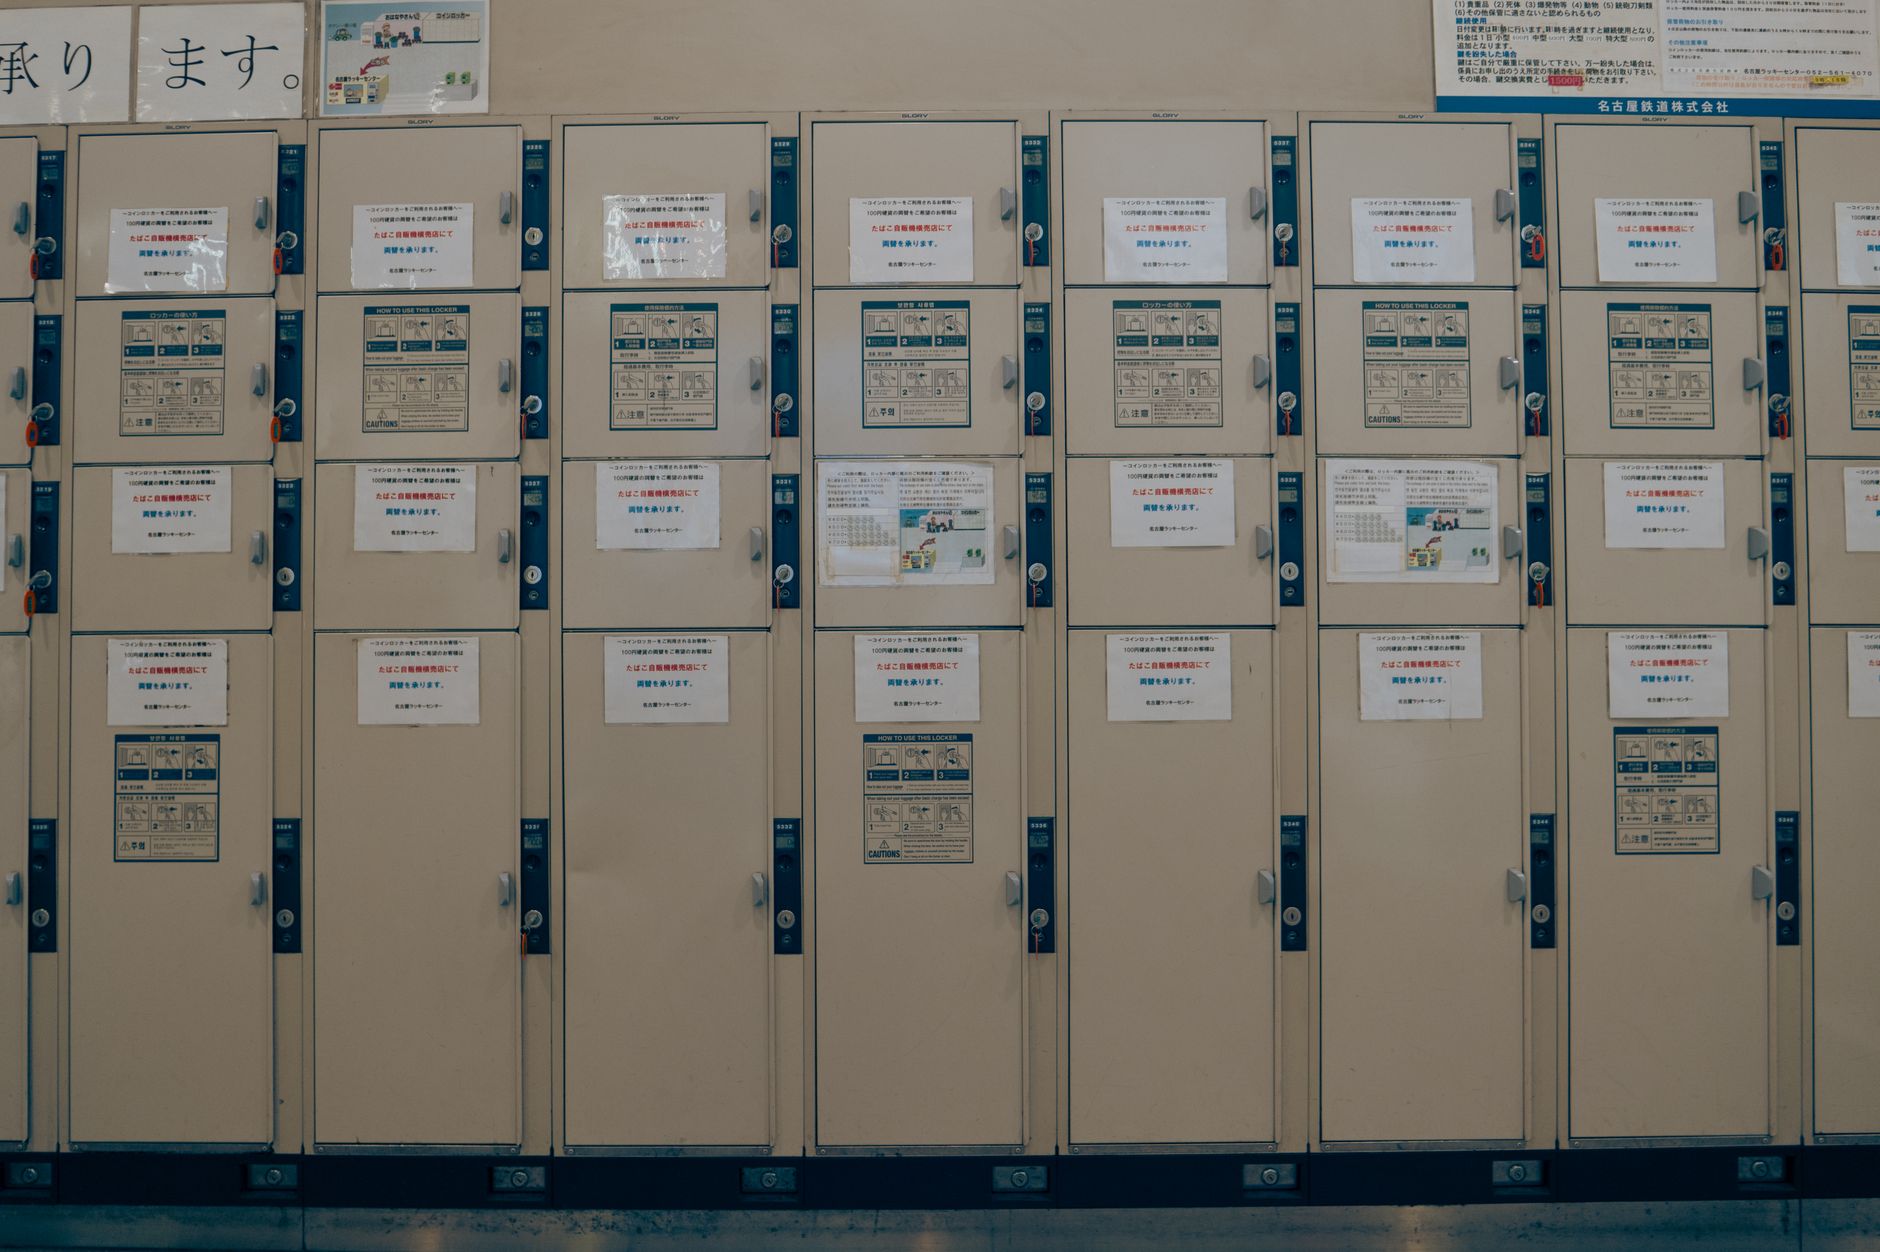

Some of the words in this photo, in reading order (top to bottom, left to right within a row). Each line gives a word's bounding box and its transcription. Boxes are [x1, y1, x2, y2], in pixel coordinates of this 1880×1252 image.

[161, 34, 300, 90] ます。
[0, 41, 92, 94] 承り
[1598, 100, 1729, 113] 名古屋鉄道株式会社
[866, 209, 958, 217] 100円硬貨の両替をご希望のお客様は
[1120, 209, 1210, 217] 100円硬貨の両替をご希望のお客様は
[1368, 210, 1456, 218] 100円硬貨の両替をご希望のお客様は
[1612, 210, 1698, 218] 100円硬貨の両替をご希望のお客様は
[370, 215, 458, 223] 100円硬貨の両替をご希望のお客様は
[871, 223, 953, 233] たばこ自販機横売店にて
[1125, 223, 1206, 232] たばこ自販機横売店にて
[1373, 224, 1453, 233] たばこ自販機横売店にて
[1616, 224, 1695, 233] たばこ自販機横売店にて
[373, 229, 454, 239] たばこ自販機横売店にて
[882, 239, 938, 249] 両替を承ります。
[1136, 239, 1192, 249] 両替を承ります。
[1384, 239, 1438, 249] 両替を承ります。
[1628, 239, 1681, 249] 両替を承ります。
[383, 245, 438, 255] 両替を承ります。
[880, 408, 894, 416] 주의
[1131, 409, 1149, 418] 注意
[136, 418, 152, 427] 注意
[372, 476, 460, 484] 100円硬貨の両替をご希望のお客様は
[614, 474, 704, 482] 100円硬貨の両替をご希望のお客様は
[1128, 472, 1218, 480] 100円硬貨の両替をご希望のお客様は
[1620, 474, 1708, 482] 100円硬貨の両替をご希望のお客様は
[128, 479, 216, 487] 100円硬貨の両替をご希望のお客様は
[375, 491, 456, 500] たばこ自販機横売店にて
[618, 489, 700, 498] たばこ自販機横売店にて
[1132, 486, 1214, 496] たばこ自販機横売店にて
[1625, 488, 1705, 498] たばこ自販機横売店にて
[132, 493, 211, 503] たばこ自販機横売店にて
[385, 507, 440, 517] 両替を承ります。
[628, 505, 684, 514] 両替を承ります。
[1143, 503, 1199, 512] 両替を承ります。
[1636, 504, 1690, 514] 両替を承ります。
[142, 510, 196, 519] 両替を承ります。
[872, 646, 964, 654] 100円硬貨の両替をご希望のお客様は
[1124, 646, 1214, 654] 100円硬貨の両替をご希望のお客様は
[1376, 644, 1466, 652] 100円硬貨の両替をご希望のお客様は
[1624, 643, 1712, 651] 100円硬貨の両替をご希望のお客様は
[124, 651, 212, 659] 100円硬貨の両替をご希望のお客様は
[374, 650, 464, 658] 100円硬貨の両替をご希望のお客様は
[622, 648, 712, 656] 100円硬貨の両替をご希望のお客様は
[876, 661, 959, 670] たばこ自販機横売店にて
[1128, 660, 1211, 670] たばこ自販機横売店にて
[1380, 659, 1462, 668] たばこ自販機横売店にて
[1629, 658, 1709, 667] たばこ自販機横売店にて
[128, 666, 208, 675] たばこ自販機横売店にて
[379, 664, 459, 674] たばこ自販機横売店にて
[626, 663, 708, 672] たばこ自販機横売店にて
[637, 679, 693, 688] 両替を承ります。
[887, 677, 944, 687] 両替を承ります。
[1139, 677, 1196, 686] 両替を承ります。
[1391, 675, 1447, 685] 両替を承ります。
[1640, 674, 1694, 684] 両替を承ります。
[138, 681, 193, 691] 両替を承ります。
[389, 680, 444, 690] 両替を承ります。
[131, 841, 145, 850] 주의
